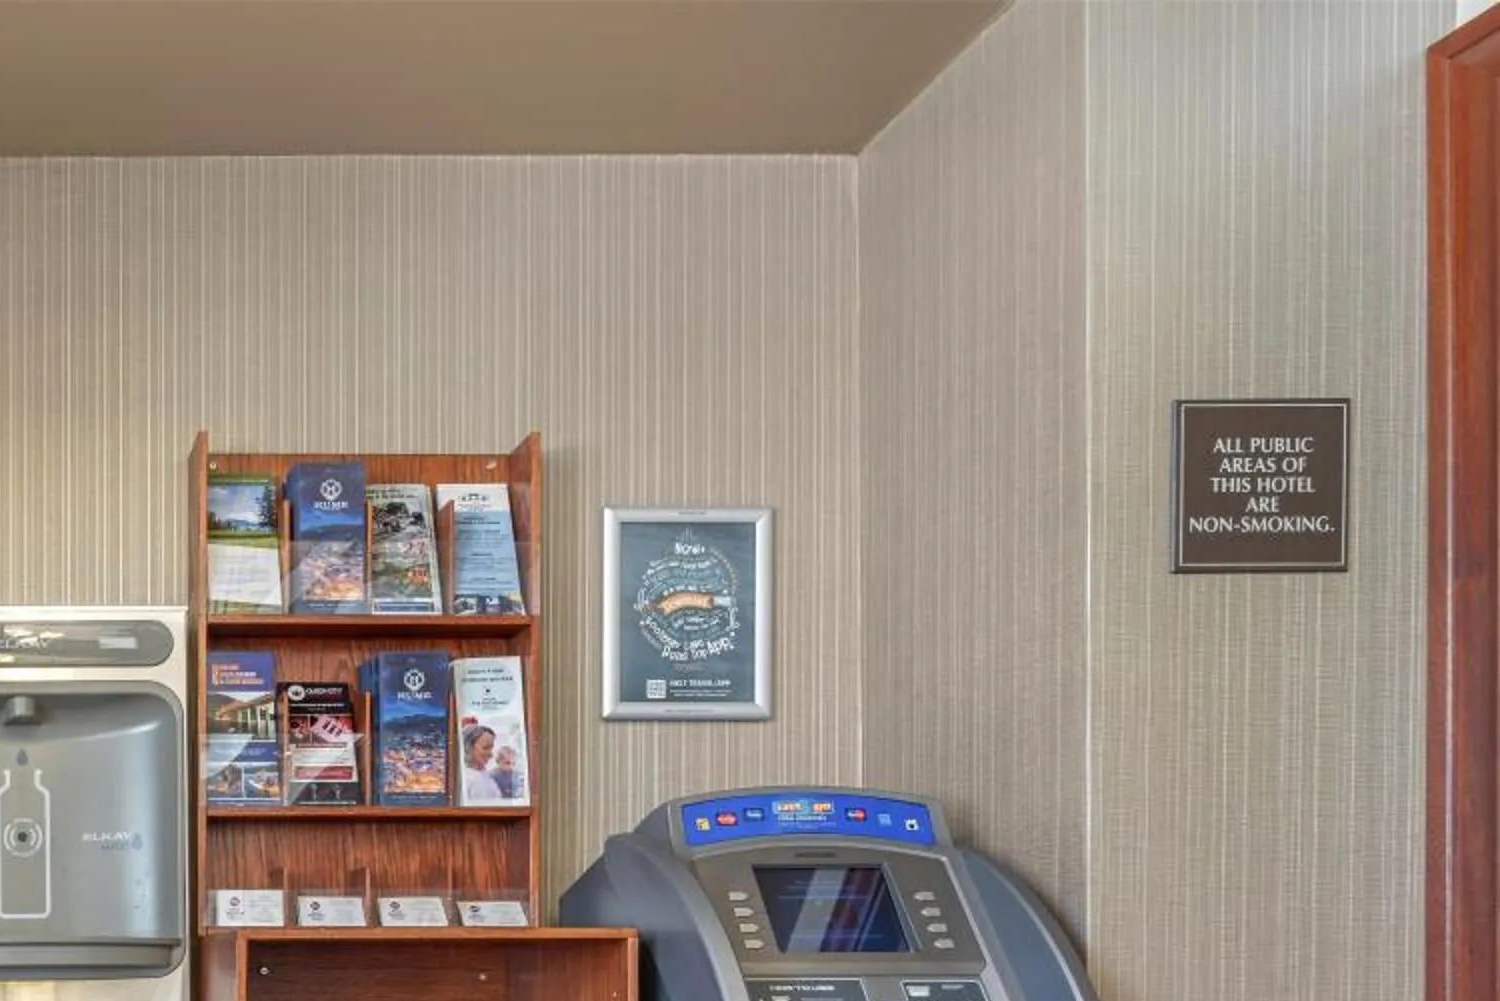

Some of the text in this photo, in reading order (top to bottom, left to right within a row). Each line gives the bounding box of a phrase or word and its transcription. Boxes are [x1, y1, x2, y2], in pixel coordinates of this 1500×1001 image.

[1213, 437, 1315, 453] ALL PUBLIC
[1219, 457, 1307, 473] AREAS OF
[1210, 477, 1316, 493] THIS HOTEL
[1245, 496, 1280, 512] ARE
[1189, 516, 1336, 533] NON-SMOKING.
